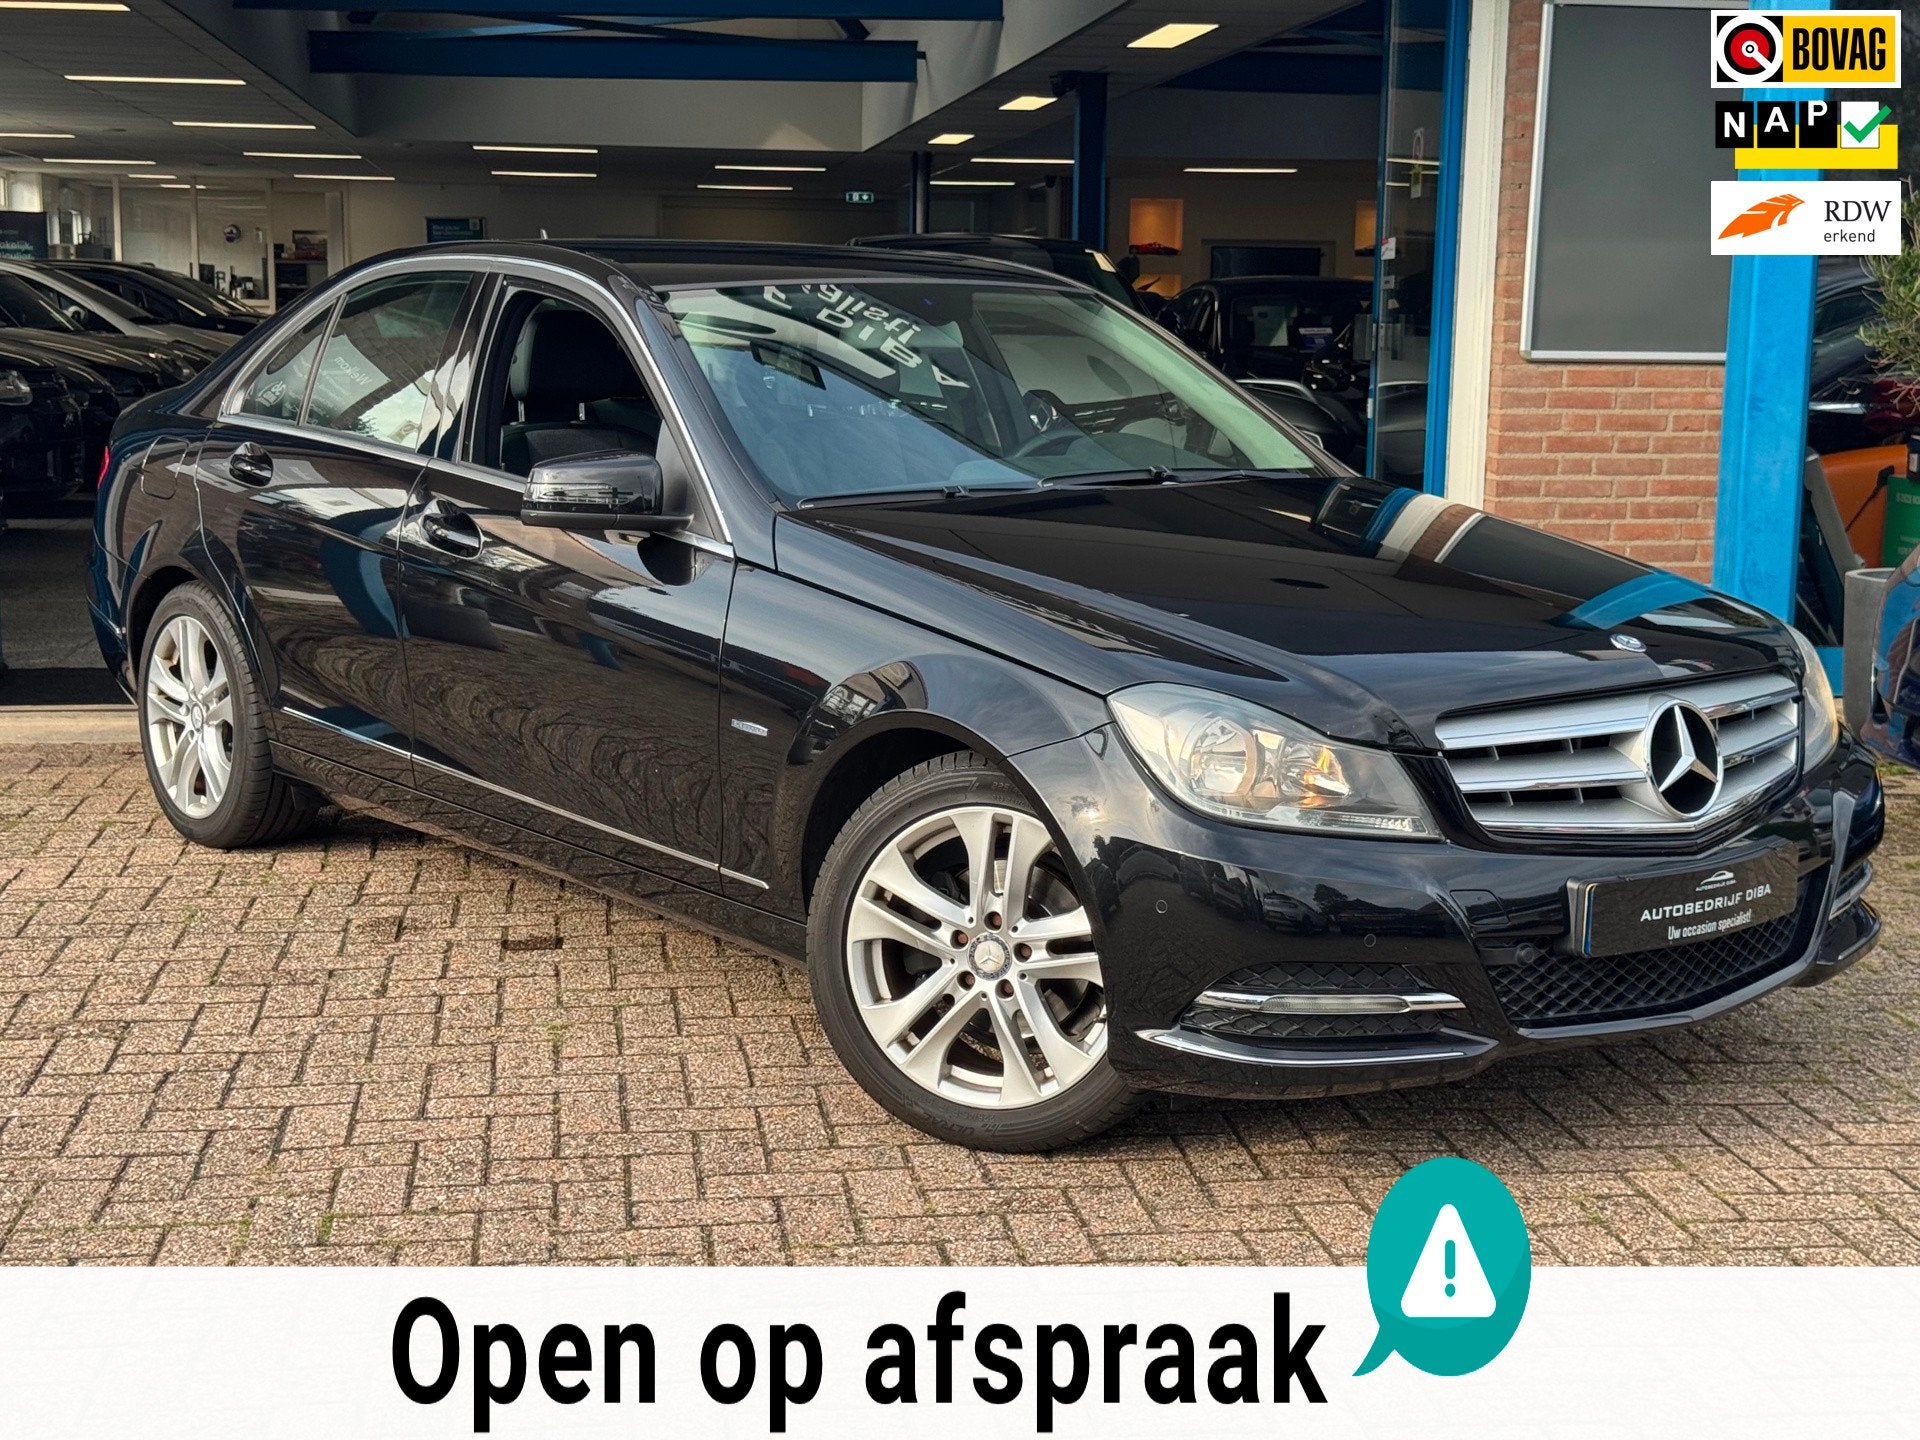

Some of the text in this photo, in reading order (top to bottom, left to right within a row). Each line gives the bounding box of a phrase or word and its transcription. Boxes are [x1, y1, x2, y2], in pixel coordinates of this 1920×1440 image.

[1640, 883, 1772, 922] AUTOBEDRIJF DIBA
[1668, 908, 1752, 940] Uw occasion specialist!
